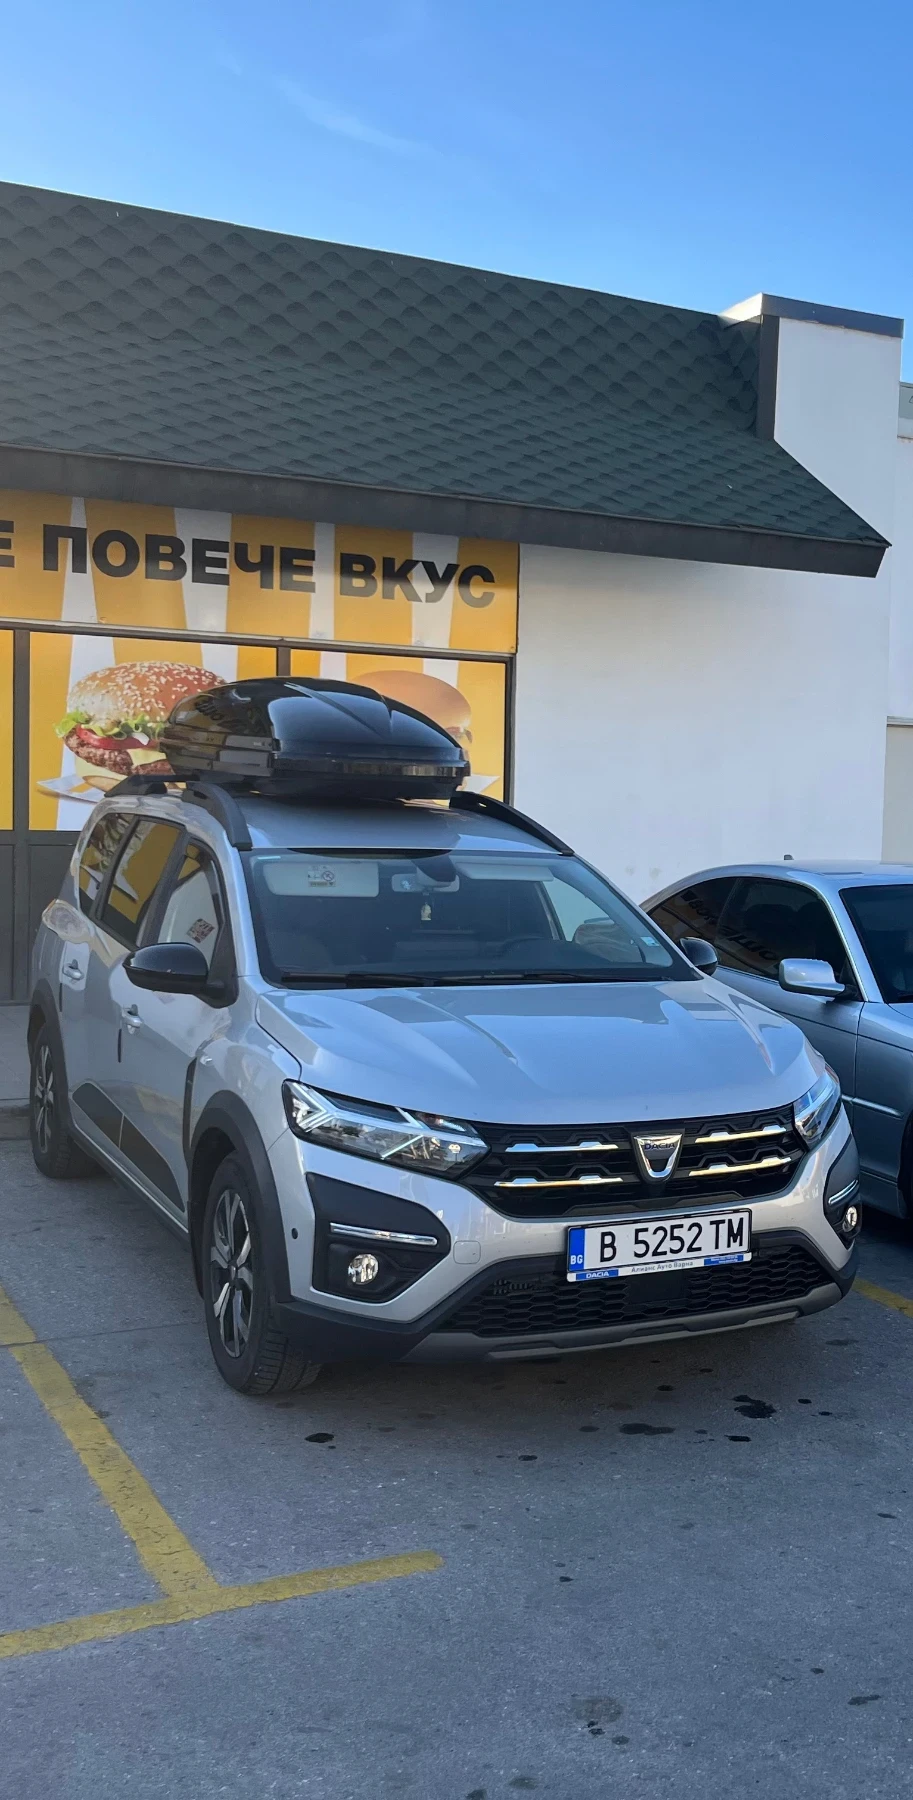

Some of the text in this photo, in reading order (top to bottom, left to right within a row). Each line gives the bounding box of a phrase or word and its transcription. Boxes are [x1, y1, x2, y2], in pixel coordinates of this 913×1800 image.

[43, 524, 316, 594] ПОВЕЧЕ
[340, 552, 496, 609] ВКУС
[600, 1217, 744, 1263] B 5252 TM
[570, 1254, 583, 1265] BG
[586, 1271, 609, 1279] DACIA
